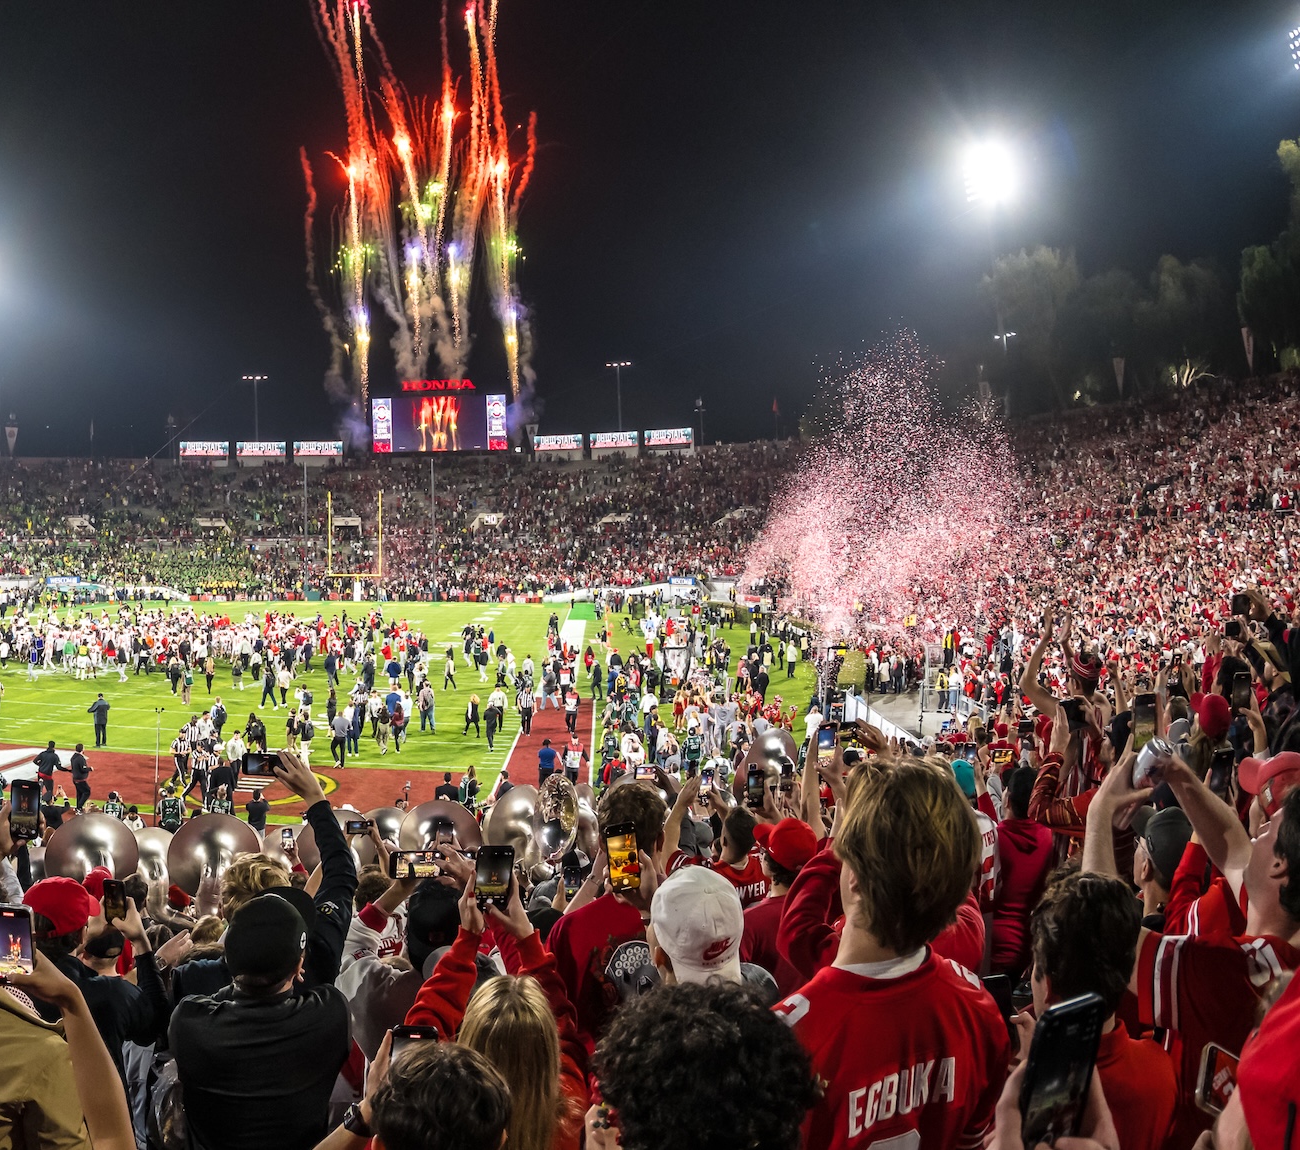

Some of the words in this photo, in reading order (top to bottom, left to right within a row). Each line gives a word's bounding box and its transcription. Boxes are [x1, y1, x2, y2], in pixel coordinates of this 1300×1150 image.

[401, 379, 476, 391] HONDA
[540, 435, 556, 445] OHIO
[557, 433, 575, 444] STATE
[596, 433, 612, 443] OHIO
[612, 432, 631, 442] STATE
[651, 430, 666, 439] OHIO
[667, 429, 685, 439] STATE
[186, 441, 202, 450] OHIO
[203, 441, 222, 450] STATE
[243, 441, 259, 450] OHIO
[260, 441, 279, 450] STATE
[300, 441, 316, 450] OHIO
[317, 441, 336, 450] STATE
[736, 880, 766, 899] WYER
[848, 1056, 956, 1139] EGBUKA
